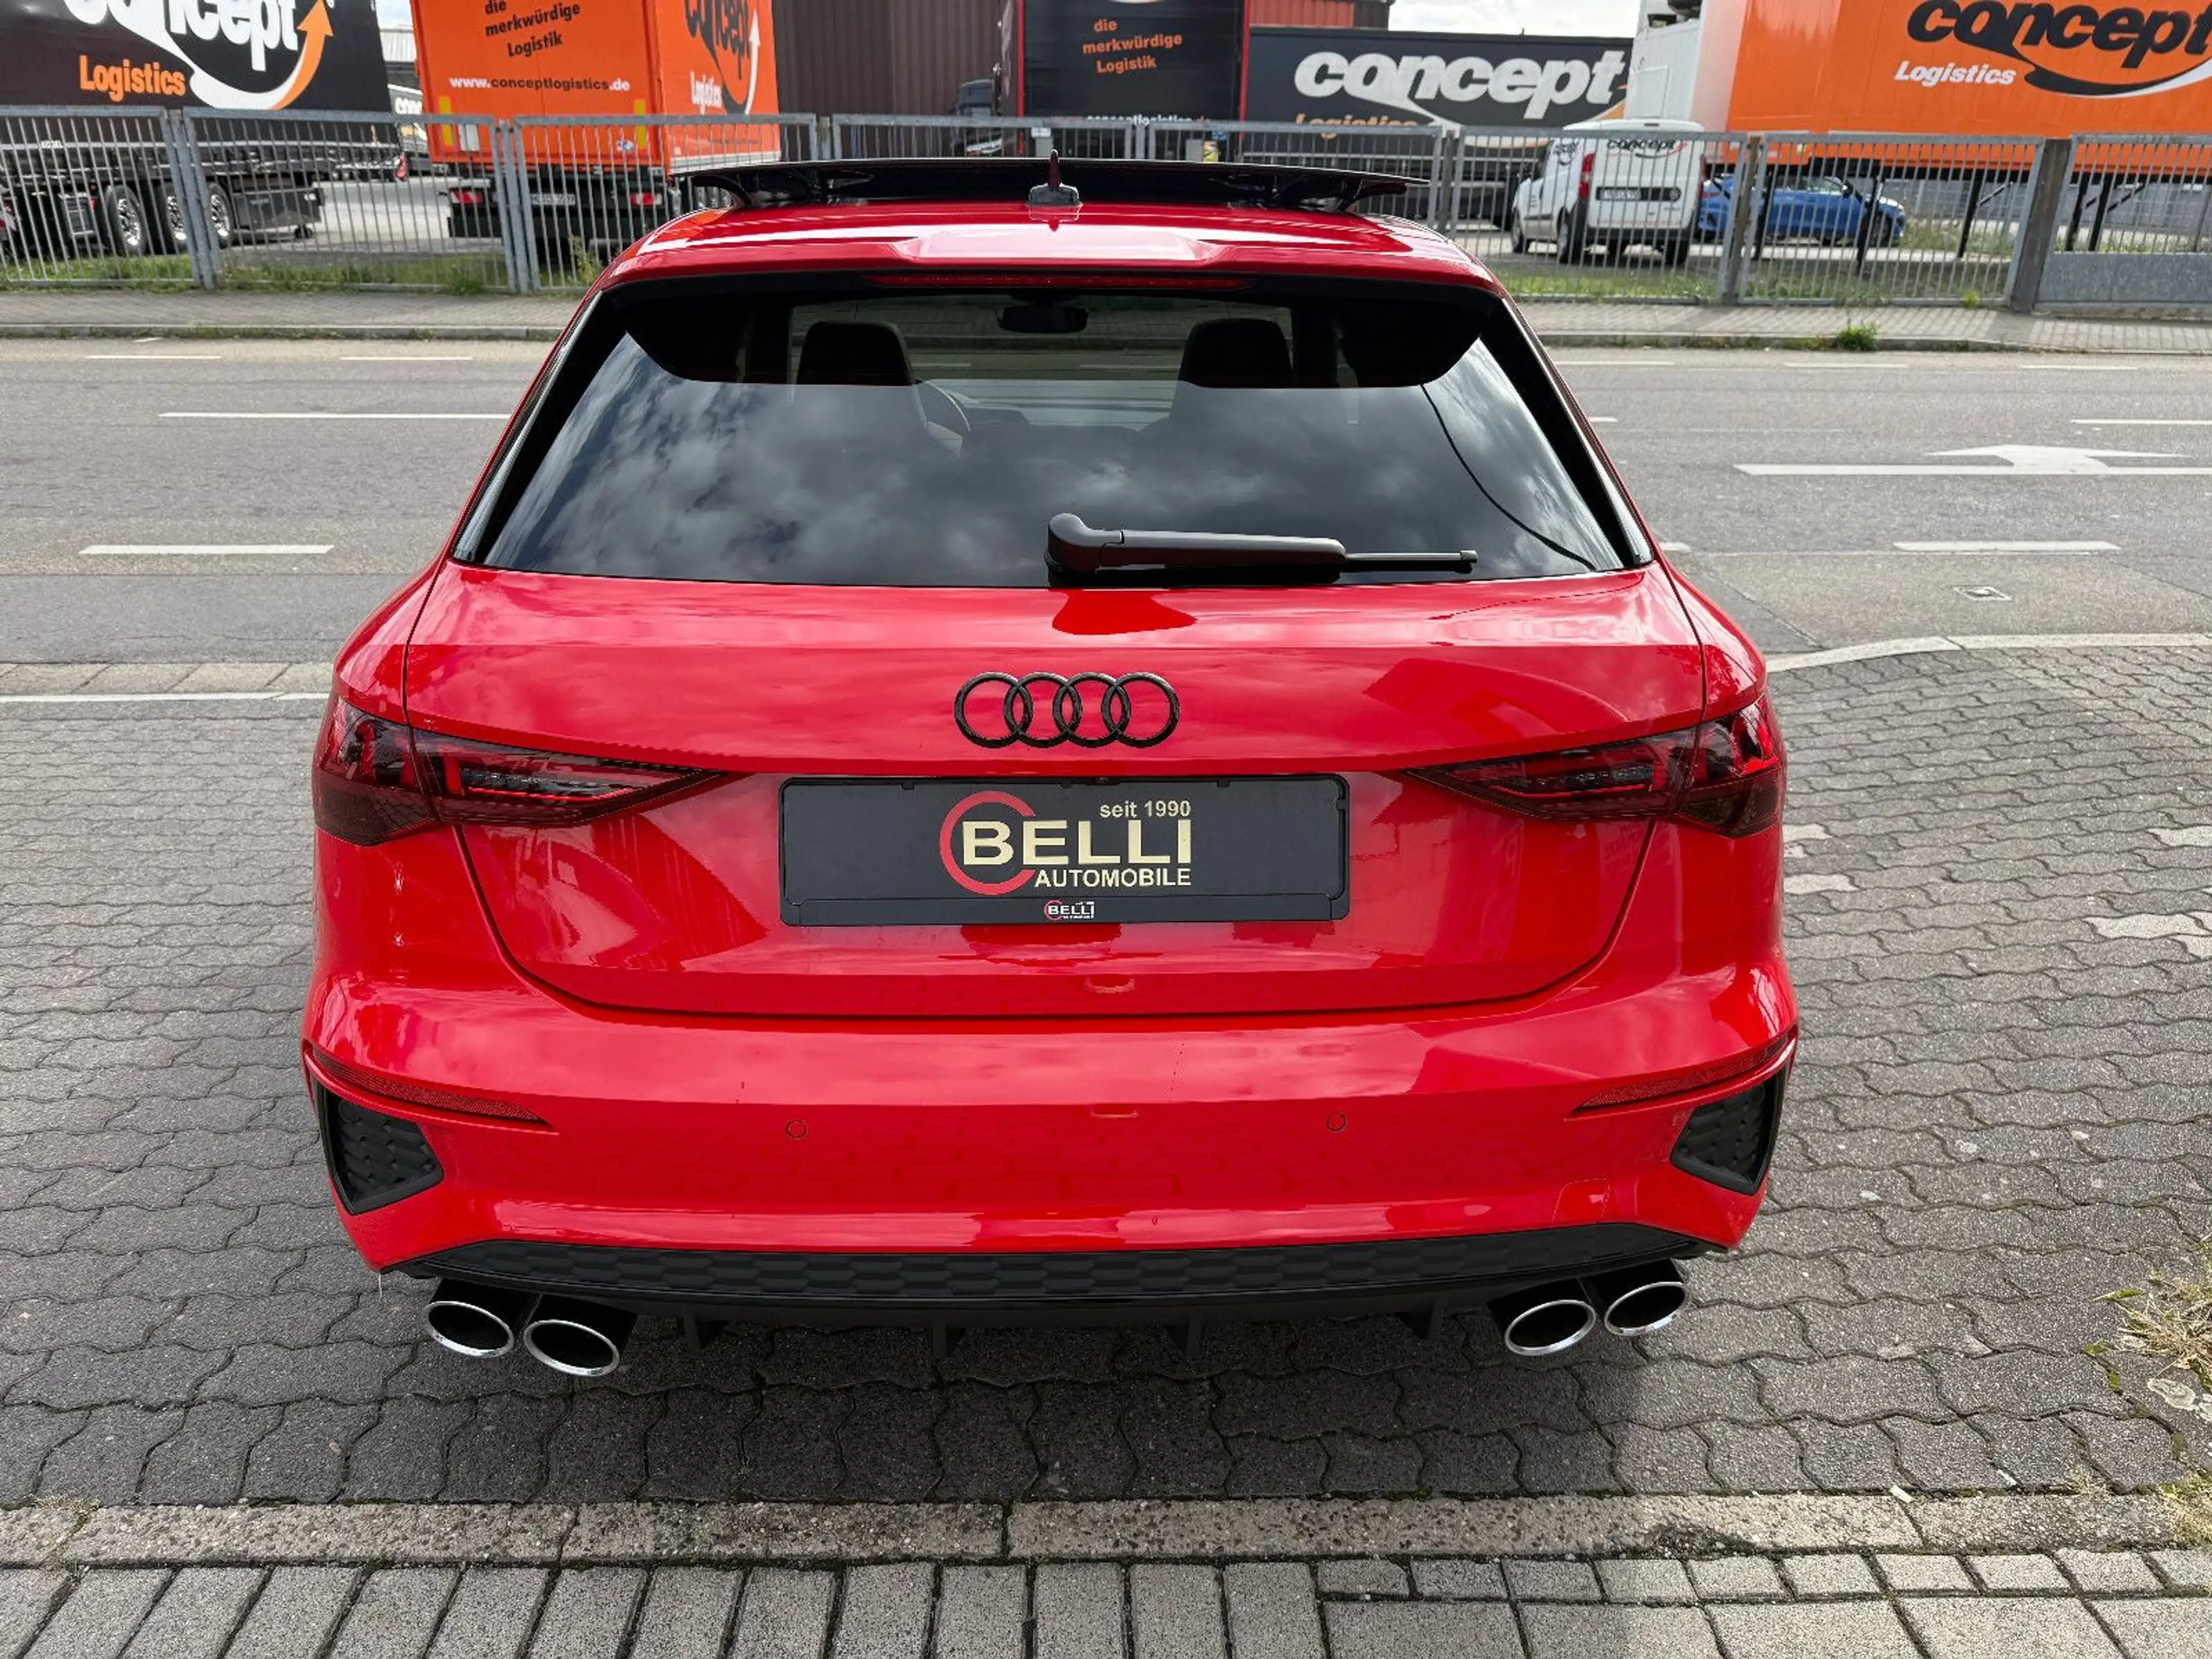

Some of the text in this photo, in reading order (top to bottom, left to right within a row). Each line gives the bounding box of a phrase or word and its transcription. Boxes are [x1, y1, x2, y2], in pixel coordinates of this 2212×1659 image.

[485, 0, 506, 15] die
[486, 3, 580, 36] merkwürdige
[1094, 19, 1118, 31] die
[507, 30, 563, 57] Logistik
[1082, 33, 1183, 54] merkwürdige
[1097, 55, 1157, 74] Logistik
[1895, 60, 2016, 87] Logistics
[79, 55, 185, 102] Logistics
[449, 77, 631, 92] www.conceptlogistics.de
[1294, 50, 1625, 119] concept
[1100, 801, 1191, 818] seit 1990
[962, 819, 1191, 865] BELLI
[1034, 868, 1191, 888] AUTOMOBILE
[1048, 905, 1094, 915] BELLI
